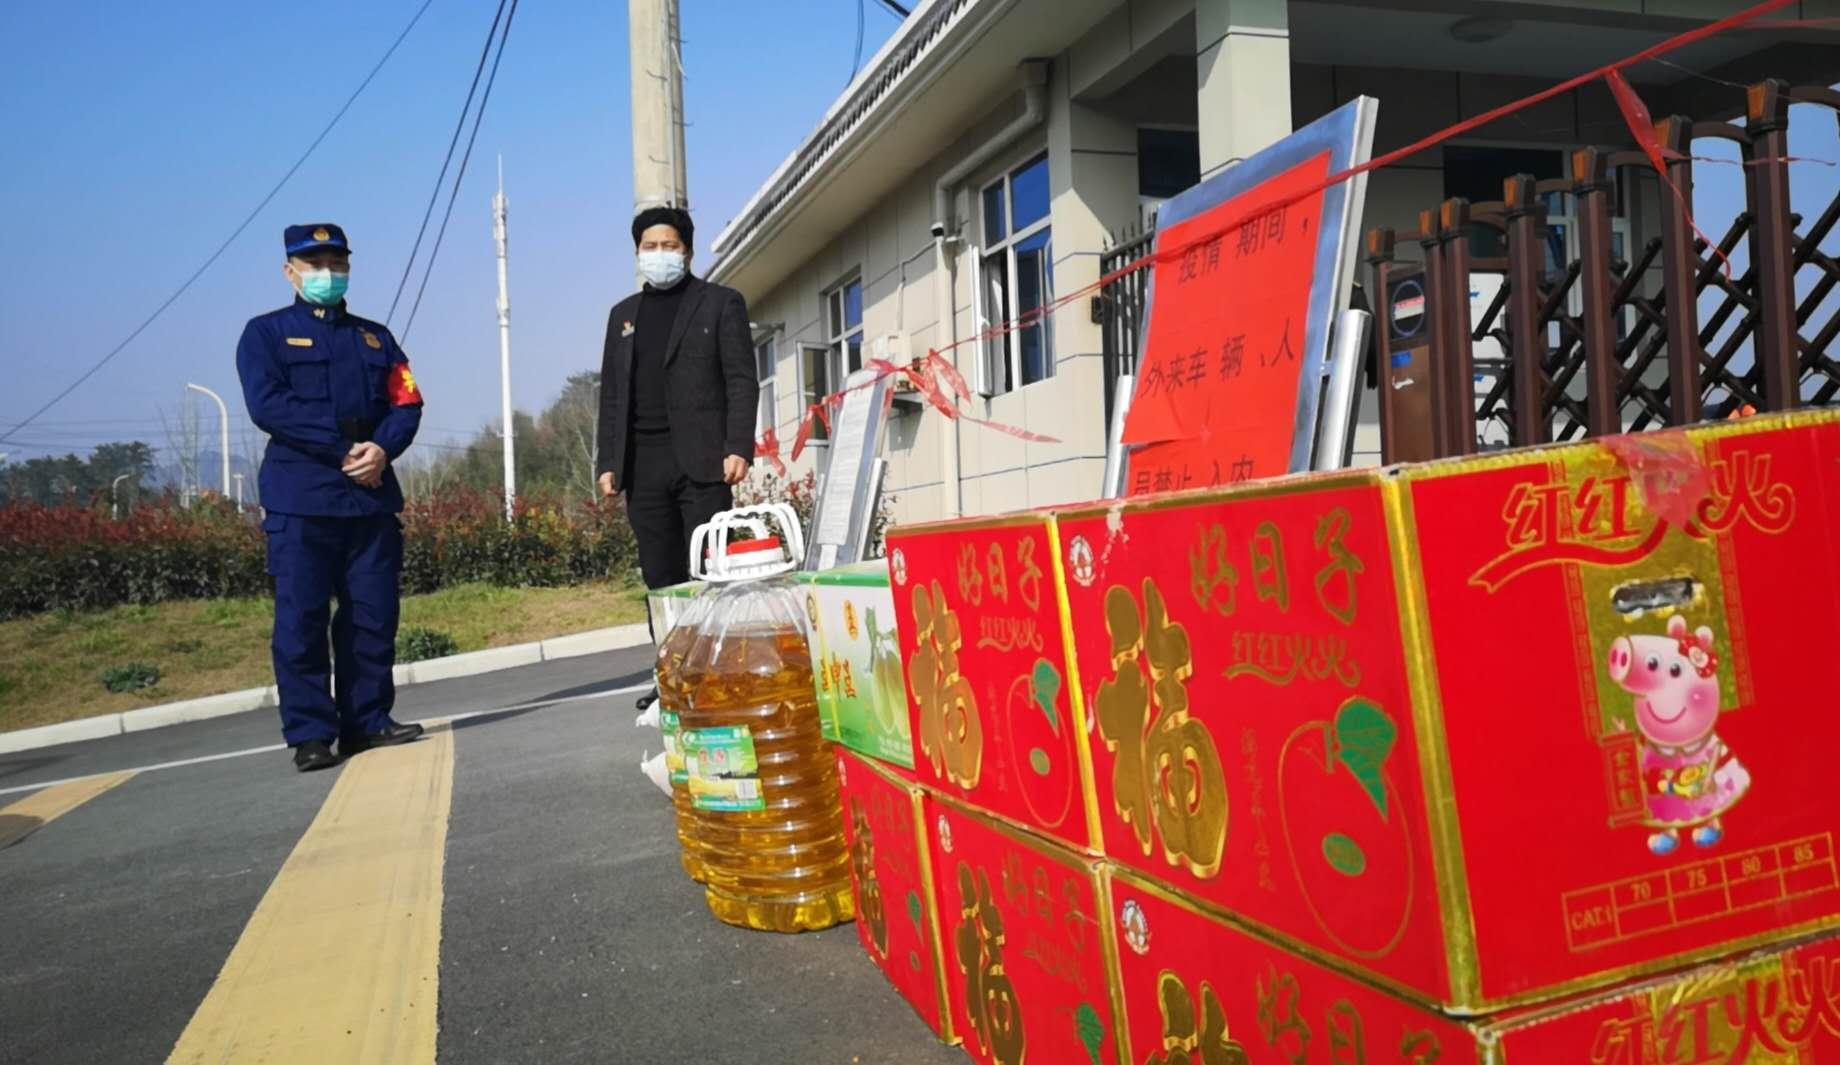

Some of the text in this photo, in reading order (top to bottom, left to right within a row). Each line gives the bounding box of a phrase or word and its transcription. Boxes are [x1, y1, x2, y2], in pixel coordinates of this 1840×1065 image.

[1188, 506, 1365, 626] 好日子
[1468, 450, 1795, 594] 红红火
[957, 536, 1043, 612] 好日子
[1630, 882, 1651, 901] 70
[1687, 869, 1708, 889] 75
